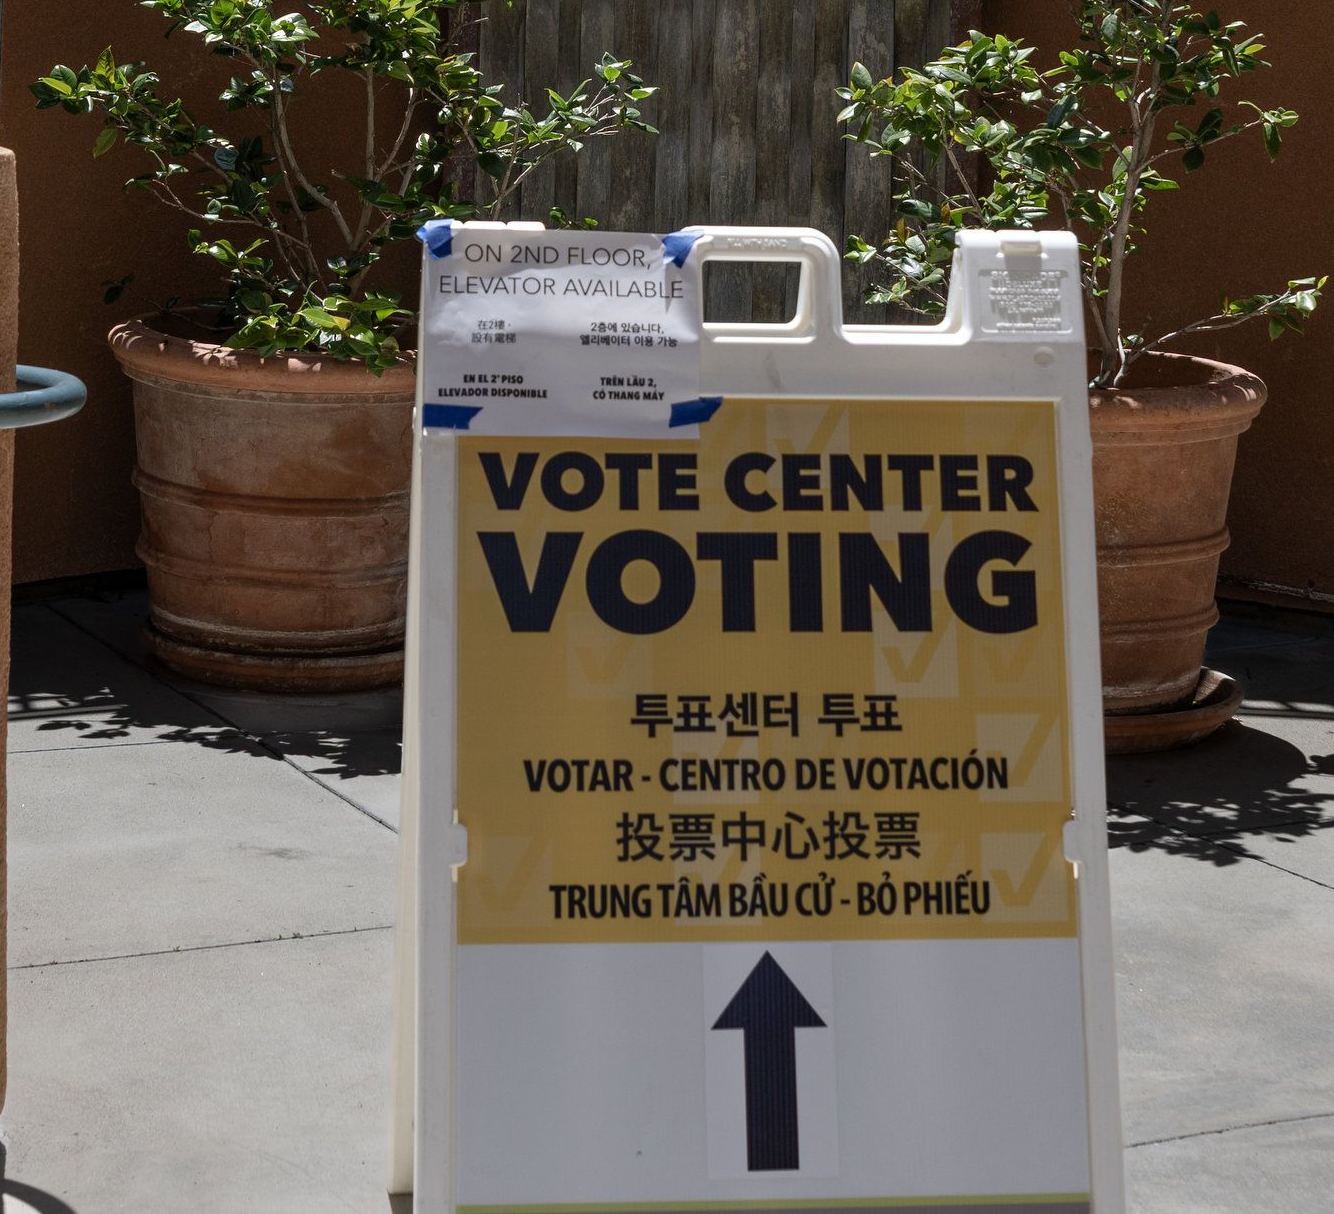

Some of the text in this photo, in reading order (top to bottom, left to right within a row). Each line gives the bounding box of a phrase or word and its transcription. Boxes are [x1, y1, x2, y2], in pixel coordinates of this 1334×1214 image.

[465, 243, 652, 270] ON 2ND FLOOR,
[439, 275, 683, 298] ELEVATOR AVAILABLE
[634, 335, 653, 346] 이용
[657, 336, 678, 347] 가능
[463, 374, 475, 383] EN
[478, 374, 488, 383] EL
[501, 375, 523, 384] PISO
[600, 375, 624, 386] TRÊN
[647, 378, 657, 388] 2,
[438, 388, 547, 398] ELEVADOR DISPONIBLE
[593, 388, 665, 401] CÓ THANG MÁY
[477, 451, 1040, 512] VOTE CENTER
[476, 530, 1039, 634] VOTING
[630, 692, 903, 737] 투표센터 투표
[523, 759, 634, 792] VOTAR
[659, 758, 785, 791] CENTRO
[796, 758, 836, 790] DE
[843, 749, 1008, 790] VOTACIÓN
[616, 810, 922, 862] 投票中心投票
[549, 884, 652, 919] TRUNG
[656, 876, 721, 918] TÂM
[729, 872, 788, 917] BẦU
[795, 871, 836, 917] CỬ
[857, 871, 897, 916] BỎ
[903, 870, 990, 915] PHIẾU
